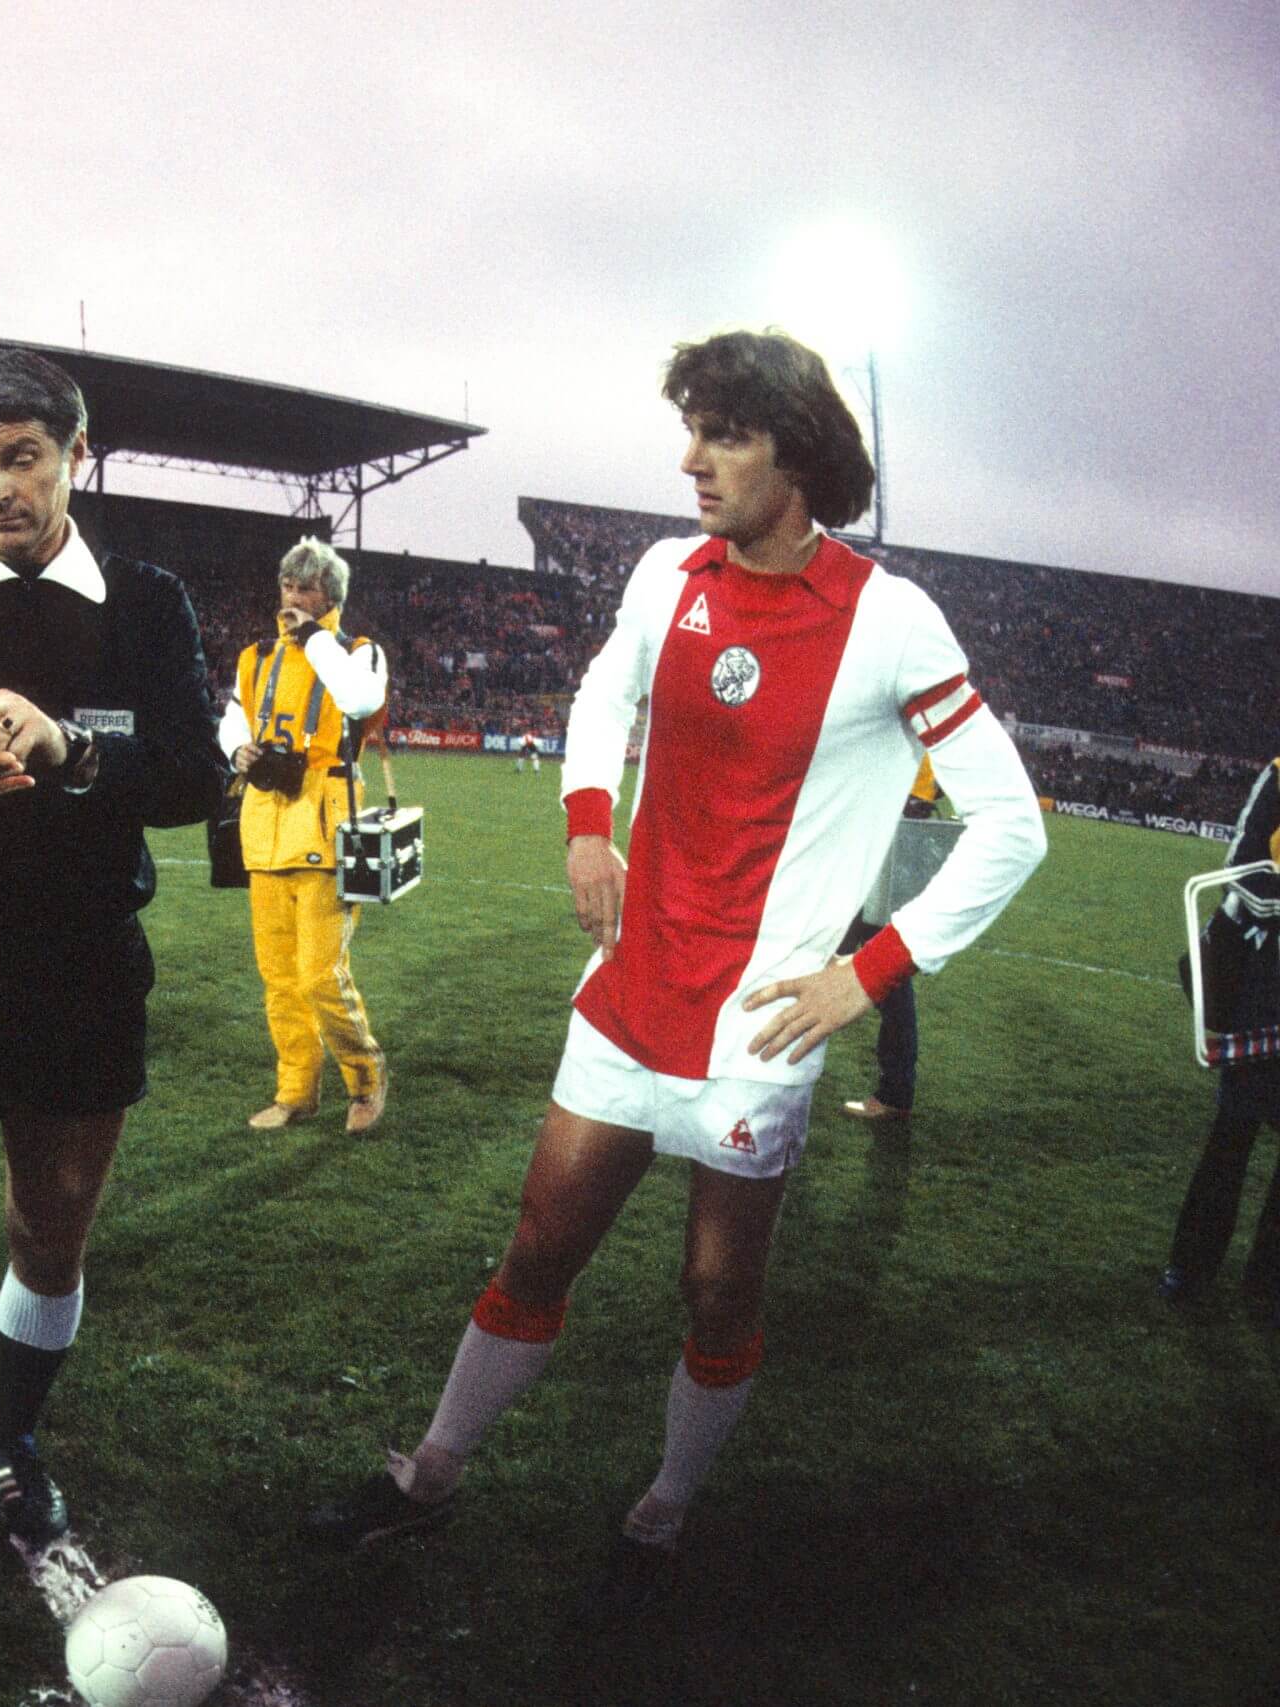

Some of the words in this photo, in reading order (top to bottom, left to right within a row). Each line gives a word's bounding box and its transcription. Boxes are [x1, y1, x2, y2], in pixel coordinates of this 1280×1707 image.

[80, 713, 128, 727] REFEREE
[1055, 799, 1109, 820] WEGA
[1144, 813, 1199, 835] WEGA
